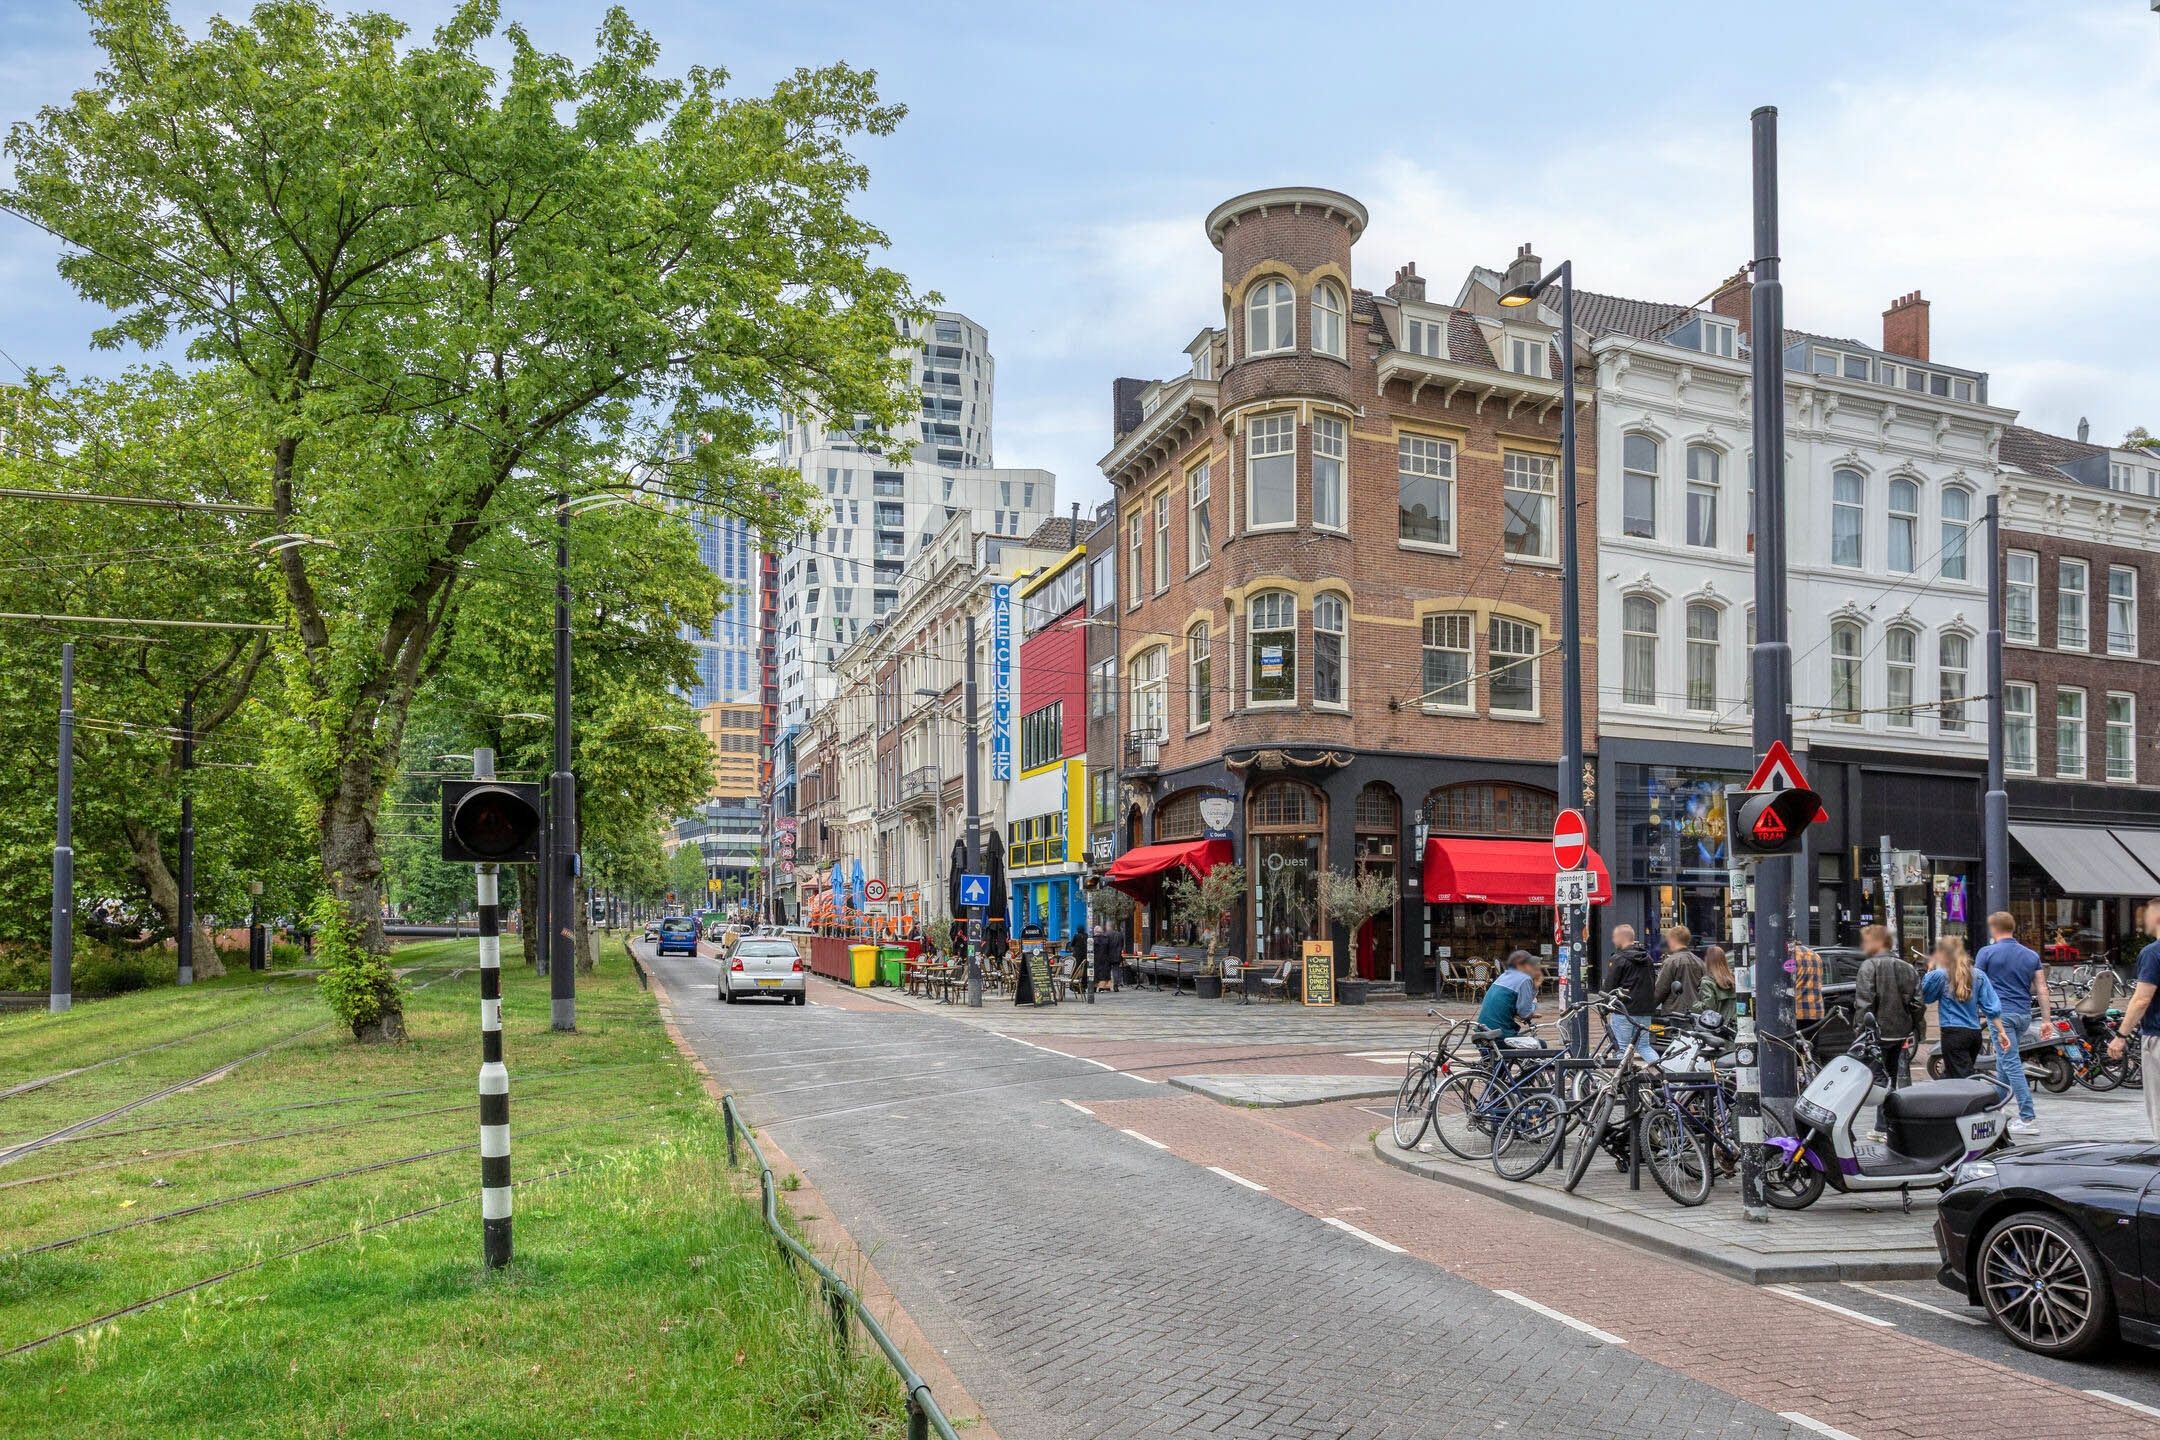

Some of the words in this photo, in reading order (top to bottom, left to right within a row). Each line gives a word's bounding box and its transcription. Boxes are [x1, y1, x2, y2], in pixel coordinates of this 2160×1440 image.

[1026, 589, 1045, 631] DE
[1048, 560, 1083, 617] UNIE
[996, 710, 1010, 780] UNIEK
[1757, 832, 1784, 840] TRAM
[869, 886, 883, 895] 30
[1971, 1119, 1997, 1141] CHECK
